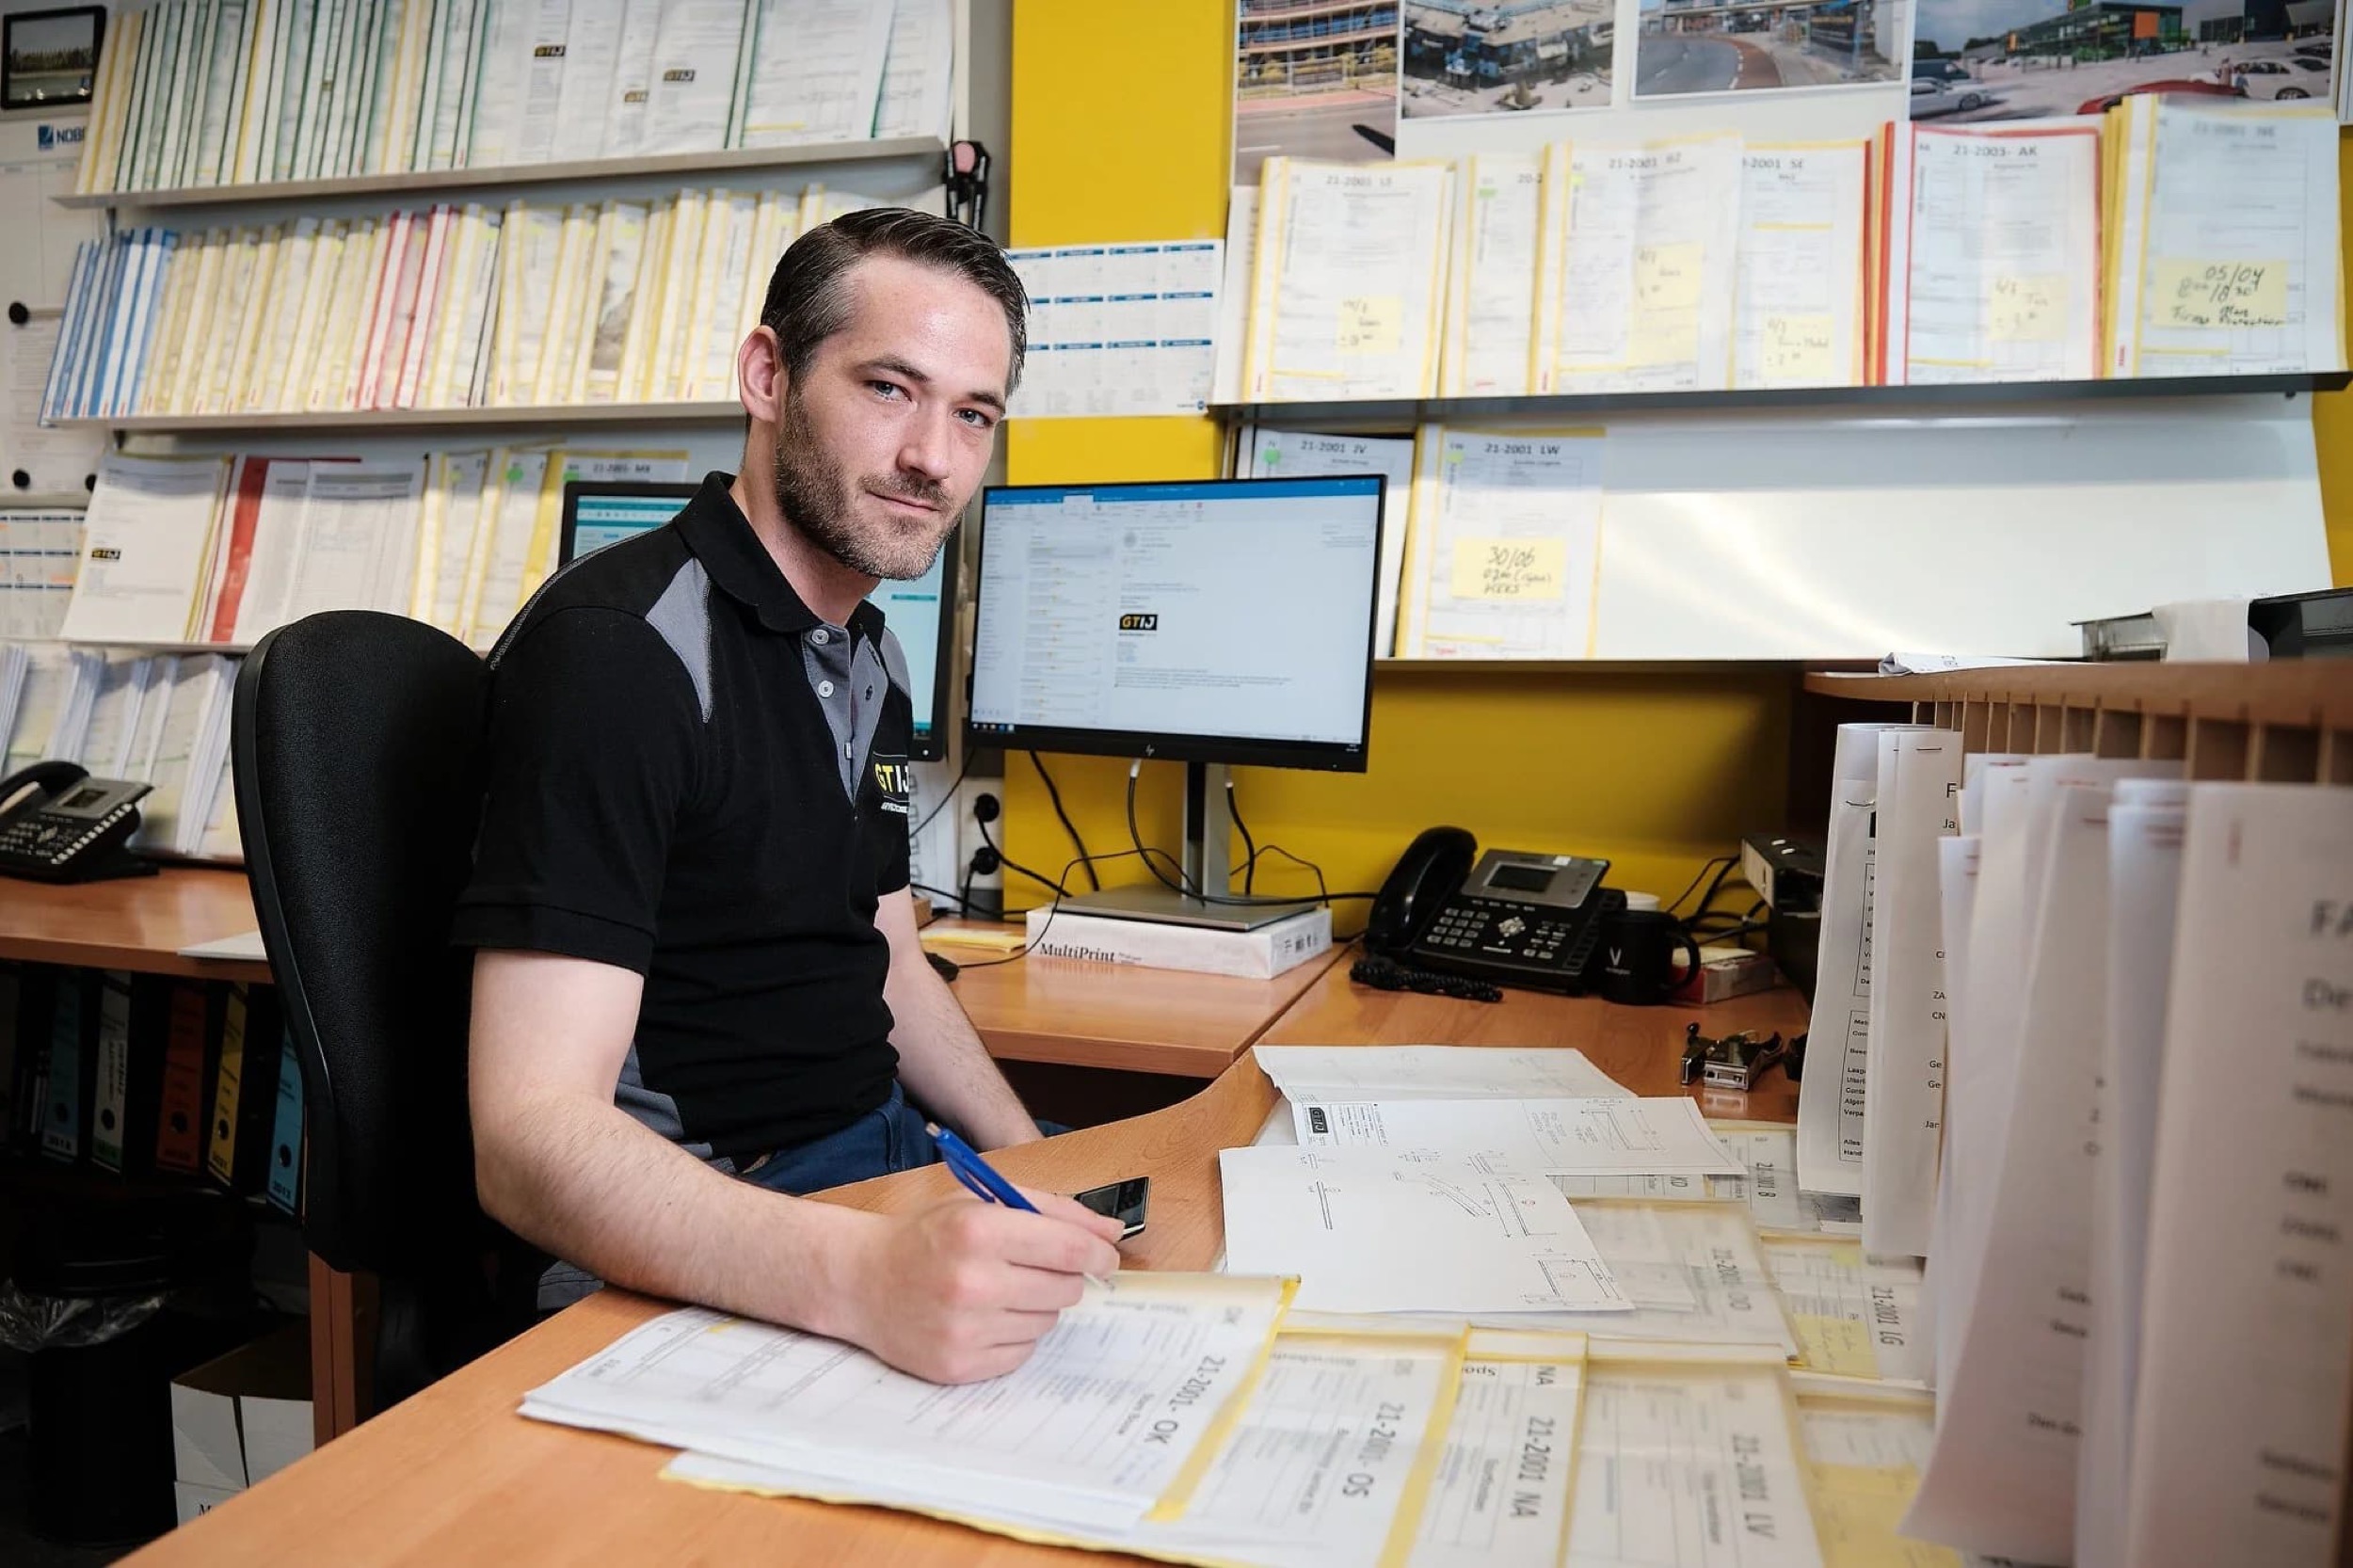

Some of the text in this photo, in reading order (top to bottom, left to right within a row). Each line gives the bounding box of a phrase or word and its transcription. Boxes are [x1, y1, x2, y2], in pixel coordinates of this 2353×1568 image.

[1300, 440, 1346, 454] 21-2001
[1485, 442, 1532, 455] 21-2001
[1121, 615, 1157, 630] GTIJ
[1040, 943, 1115, 963] MultiPrint
[1144, 1419, 1178, 1444] OK
[1509, 1416, 1555, 1517] 21-2001 NA
[1342, 1472, 1374, 1496] OS
